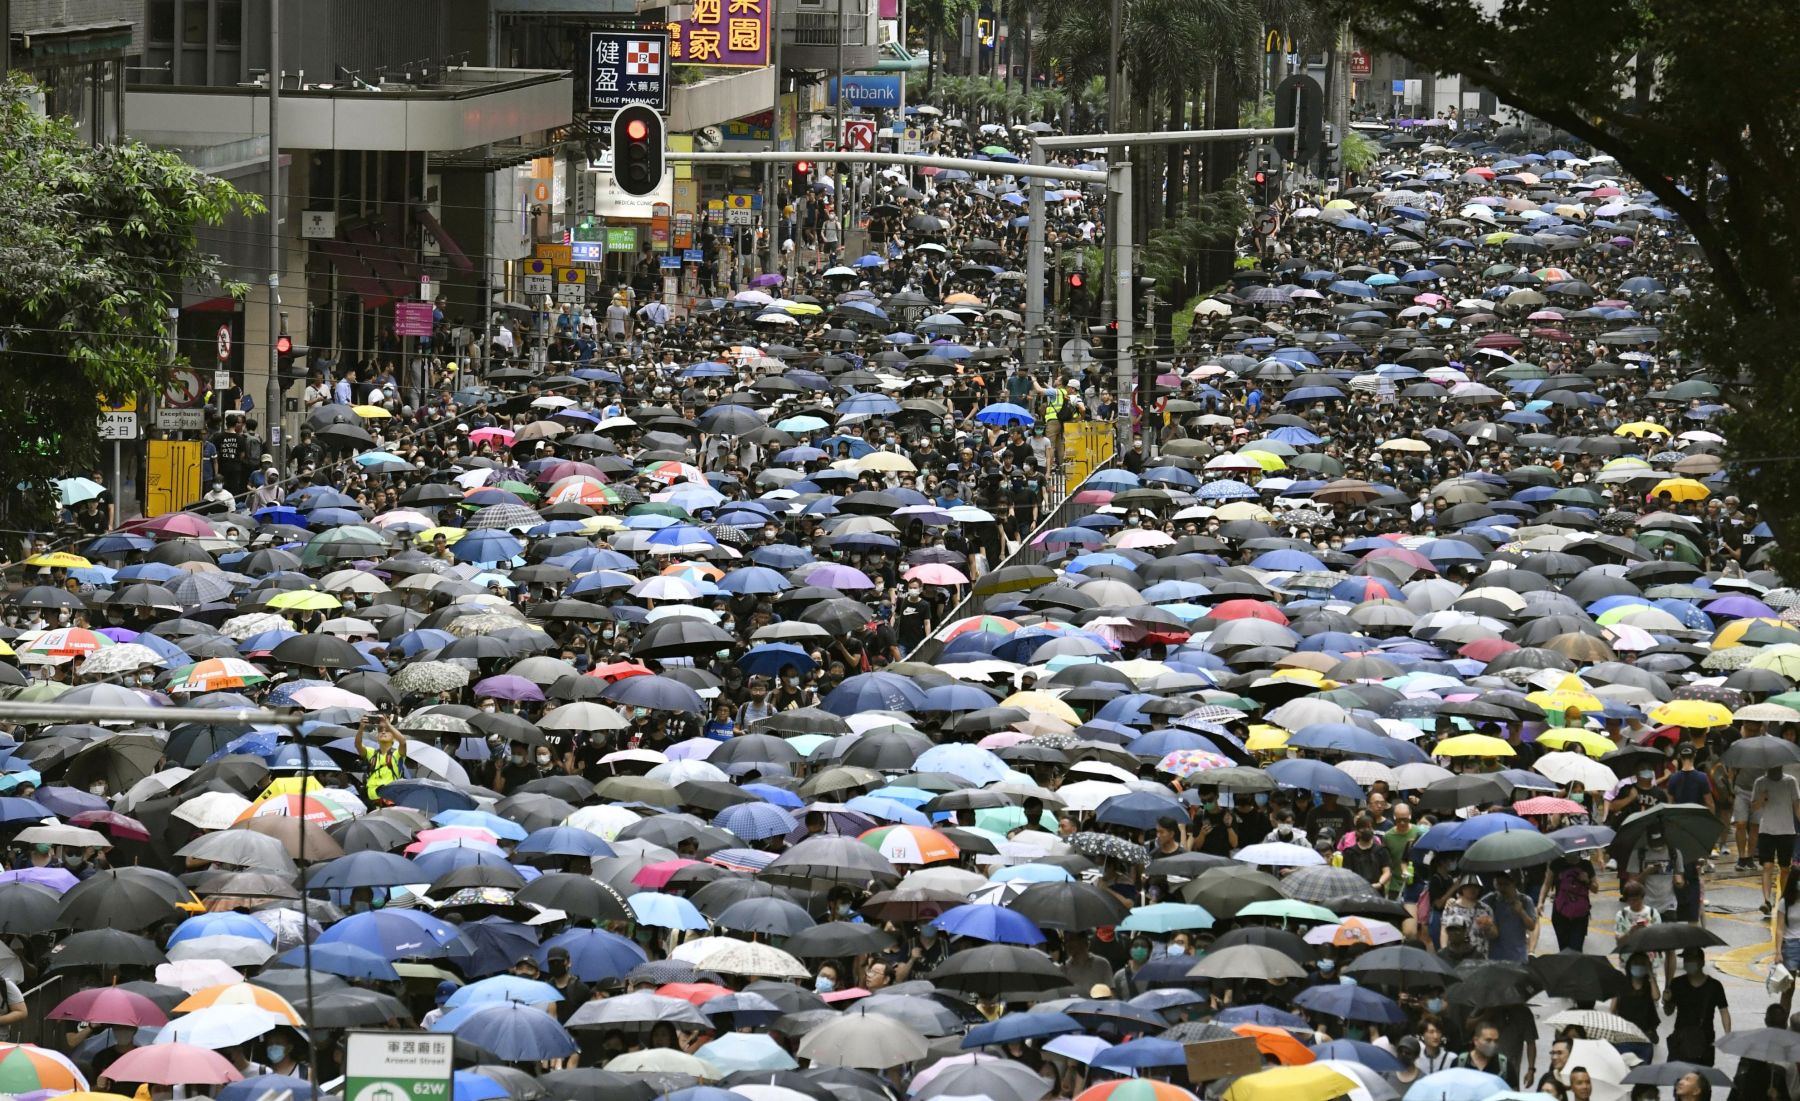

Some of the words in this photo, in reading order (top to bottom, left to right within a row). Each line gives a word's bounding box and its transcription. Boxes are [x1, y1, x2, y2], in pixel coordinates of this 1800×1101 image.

[596, 40, 619, 91] 健盈
[626, 81, 660, 92] 大藥房
[117, 415, 133, 423] hrs
[105, 426, 129, 436] 全日
[385, 1057, 417, 1065] Arsenal
[420, 1057, 446, 1065] Street
[413, 1083, 446, 1095] 62W
